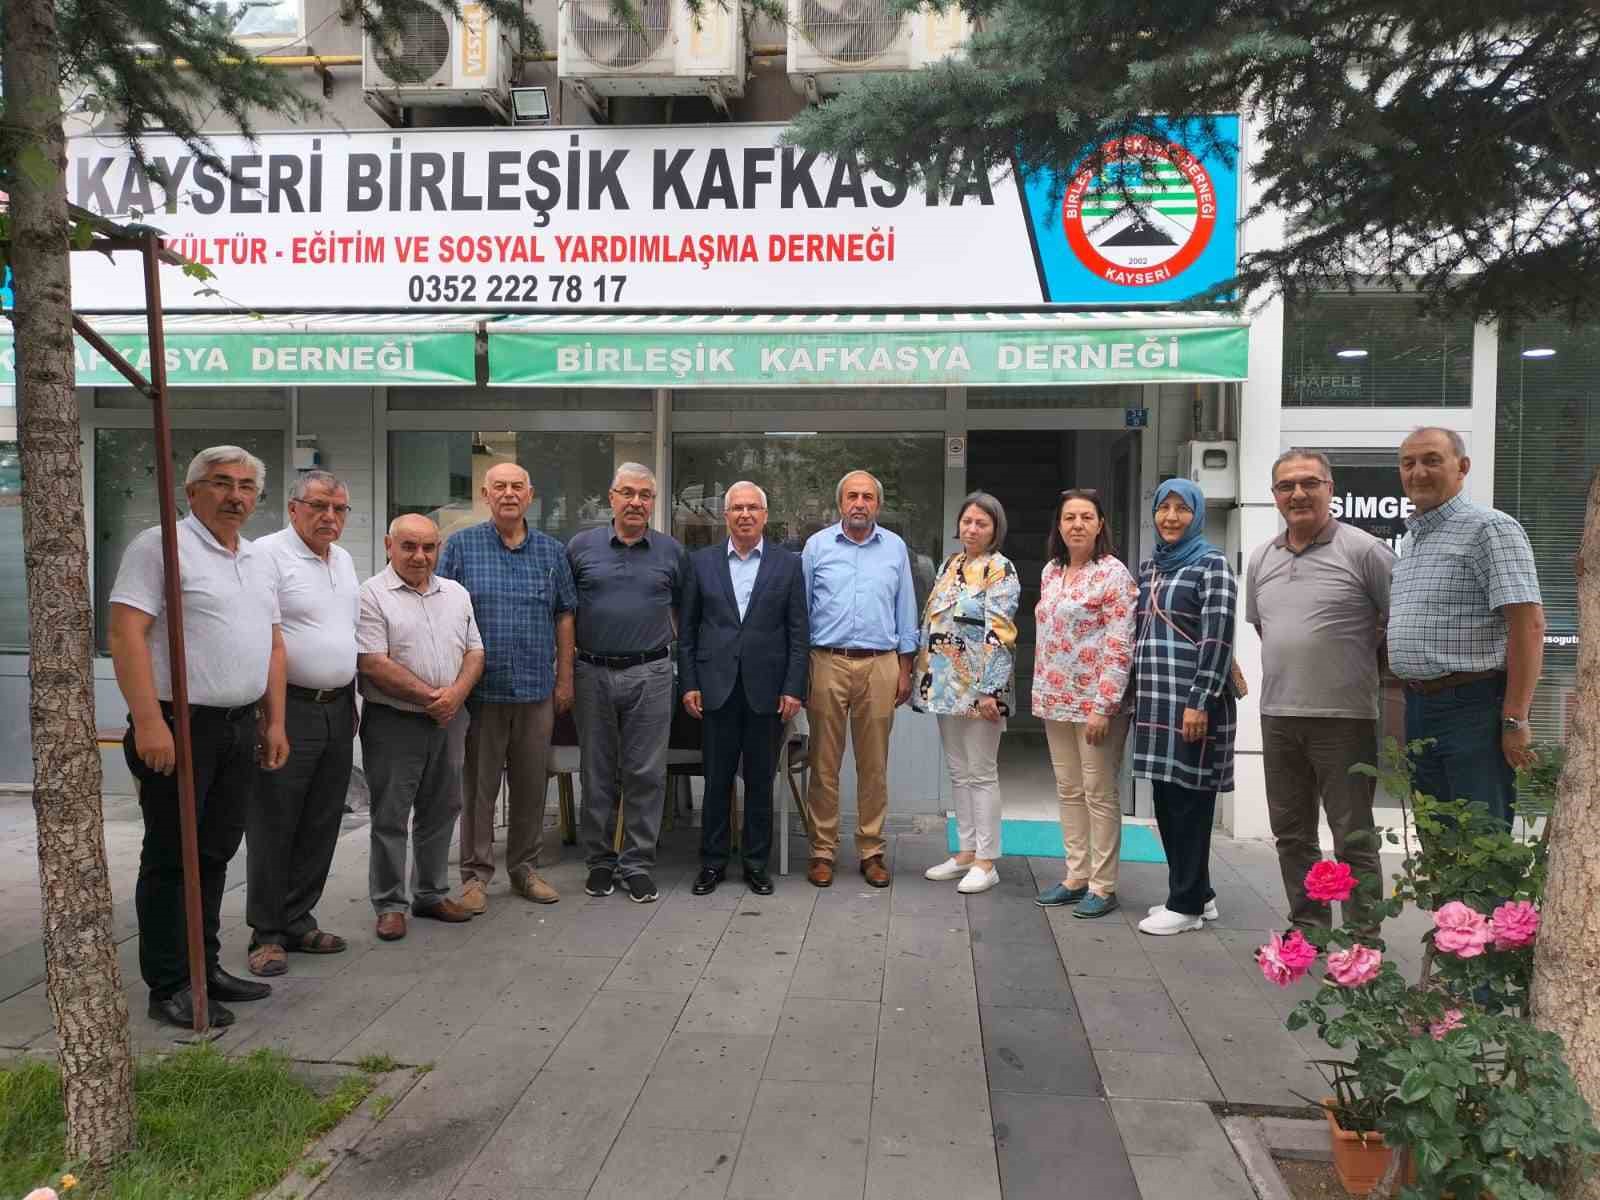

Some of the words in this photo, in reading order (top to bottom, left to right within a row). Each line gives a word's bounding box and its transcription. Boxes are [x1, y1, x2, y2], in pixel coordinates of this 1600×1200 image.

[77, 138, 321, 215] KAYSERİ
[347, 135, 630, 227] BİRLEŞİK
[292, 231, 385, 265] EĞİTİM
[394, 237, 429, 263] VE
[438, 235, 545, 263] SOSYAL
[554, 235, 759, 270] YARDIMLAŞMA
[768, 227, 895, 263] DERNEĞİ
[408, 275, 476, 302] 0352
[486, 275, 538, 302] 222
[549, 275, 582, 302] 78
[593, 275, 627, 302] 17
[1105, 266, 1171, 284] KAYSERİ
[251, 341, 415, 371] DERNEĞİ
[556, 343, 734, 378] BİRLEŞİK
[760, 347, 970, 373] KAFKASYA
[998, 336, 1179, 370] DERNEĞİ
[1328, 492, 1416, 518] SİMGE
